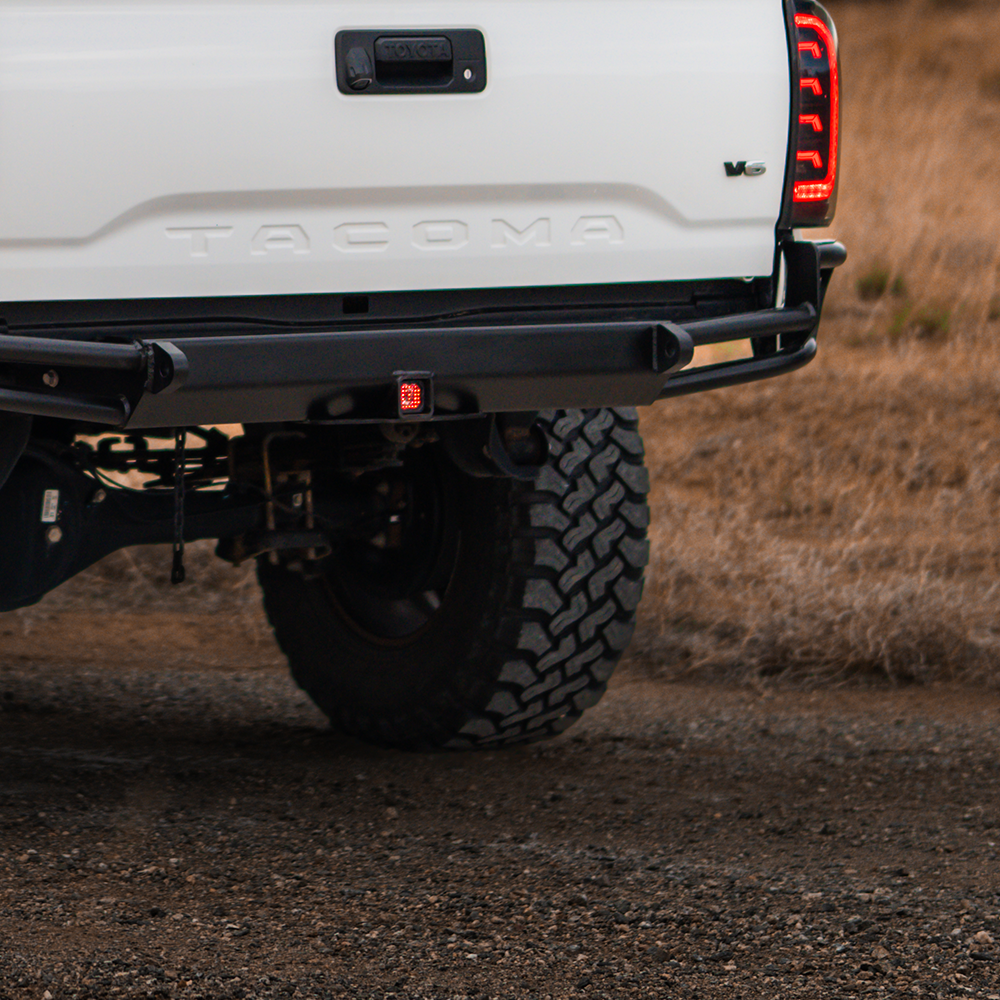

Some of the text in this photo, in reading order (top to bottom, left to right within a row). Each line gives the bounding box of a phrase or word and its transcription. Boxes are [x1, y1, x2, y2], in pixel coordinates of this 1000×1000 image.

[385, 43, 449, 58] TOYOTA
[723, 160, 767, 177] V6
[164, 214, 625, 258] TACOMA
